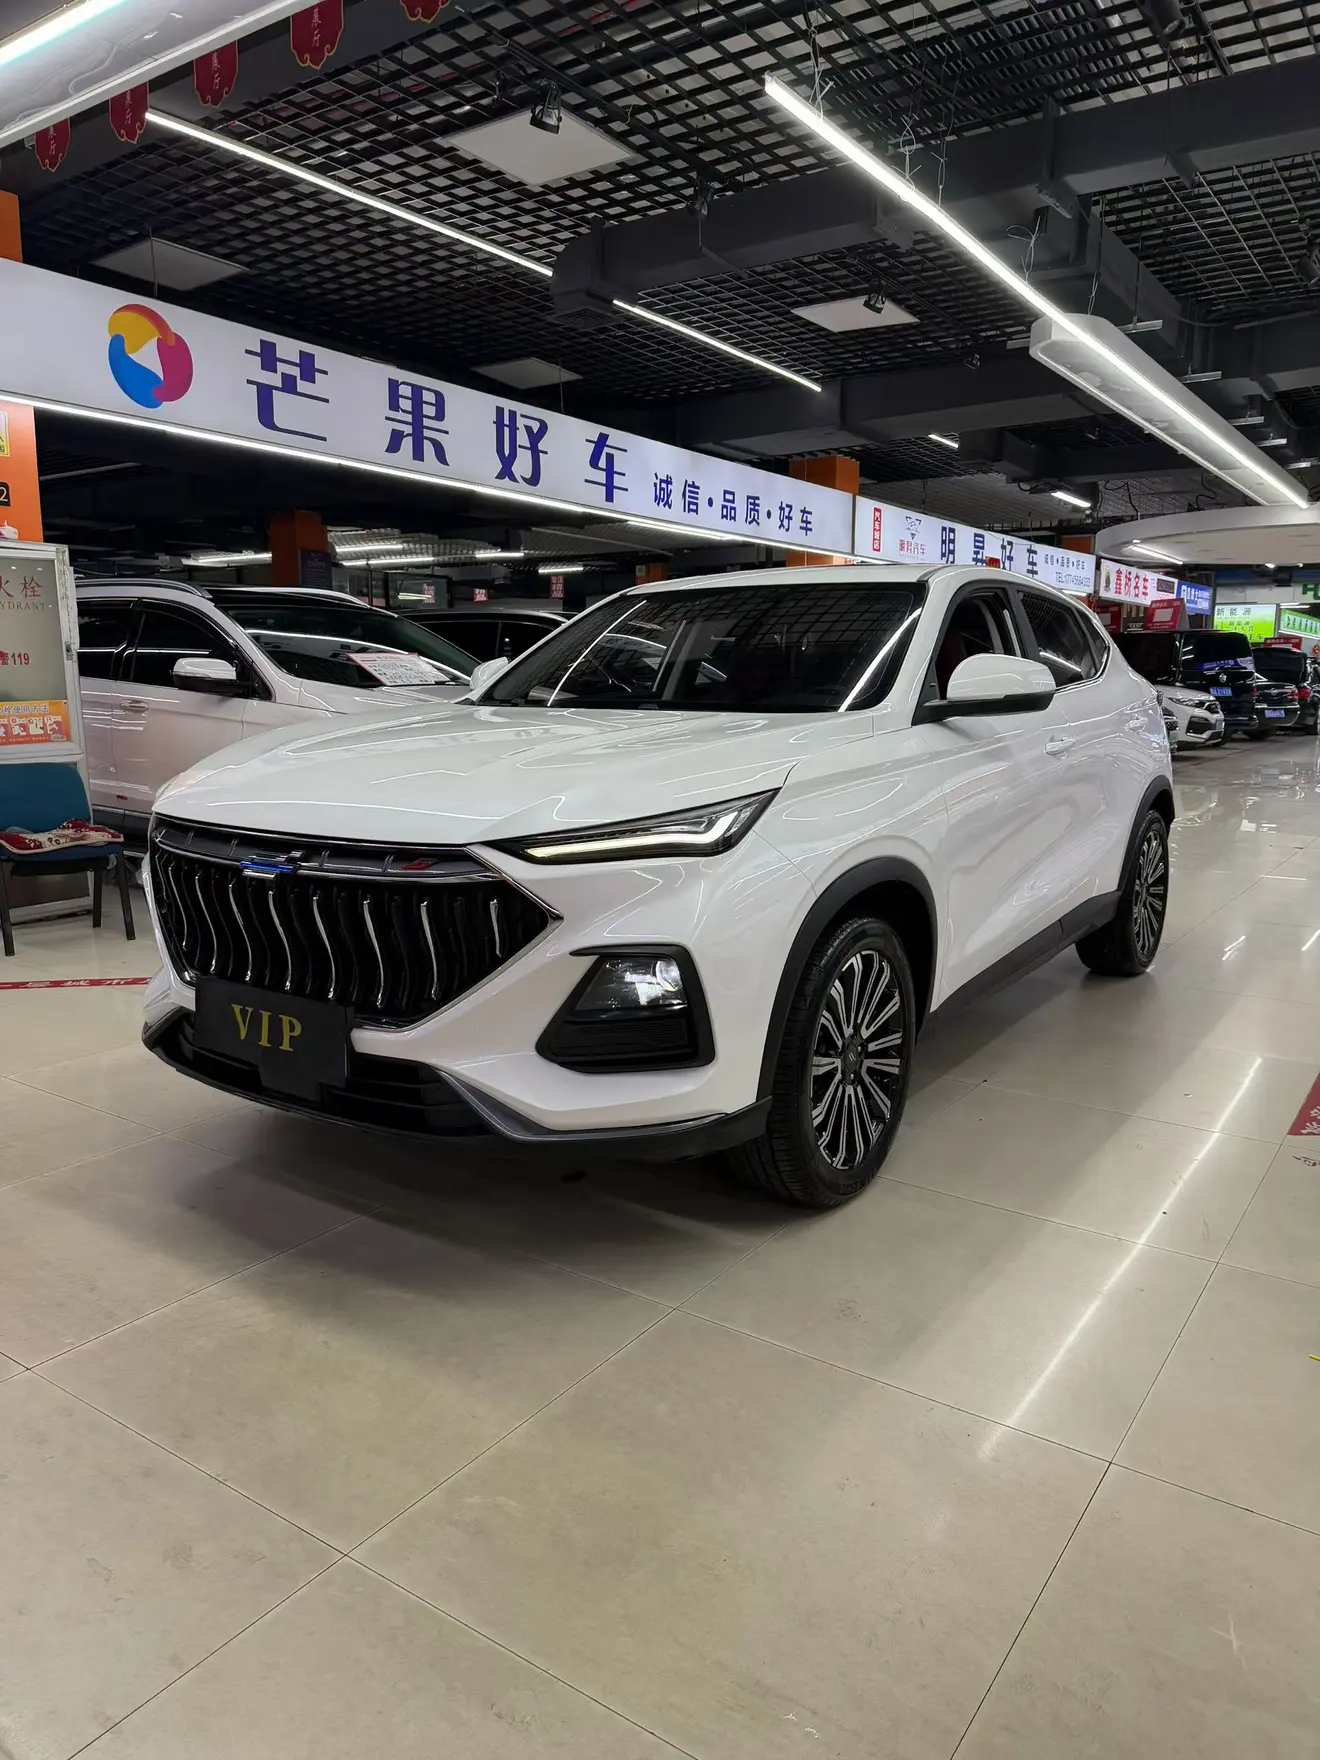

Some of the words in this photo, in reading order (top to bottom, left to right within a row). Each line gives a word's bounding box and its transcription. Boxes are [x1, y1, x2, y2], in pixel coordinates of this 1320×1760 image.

[244, 338, 629, 504] 芒果好车
[1114, 567, 1150, 601] 鑫桥名车
[1216, 607, 1251, 616] 新能源
[231, 1003, 302, 1052] VIP
